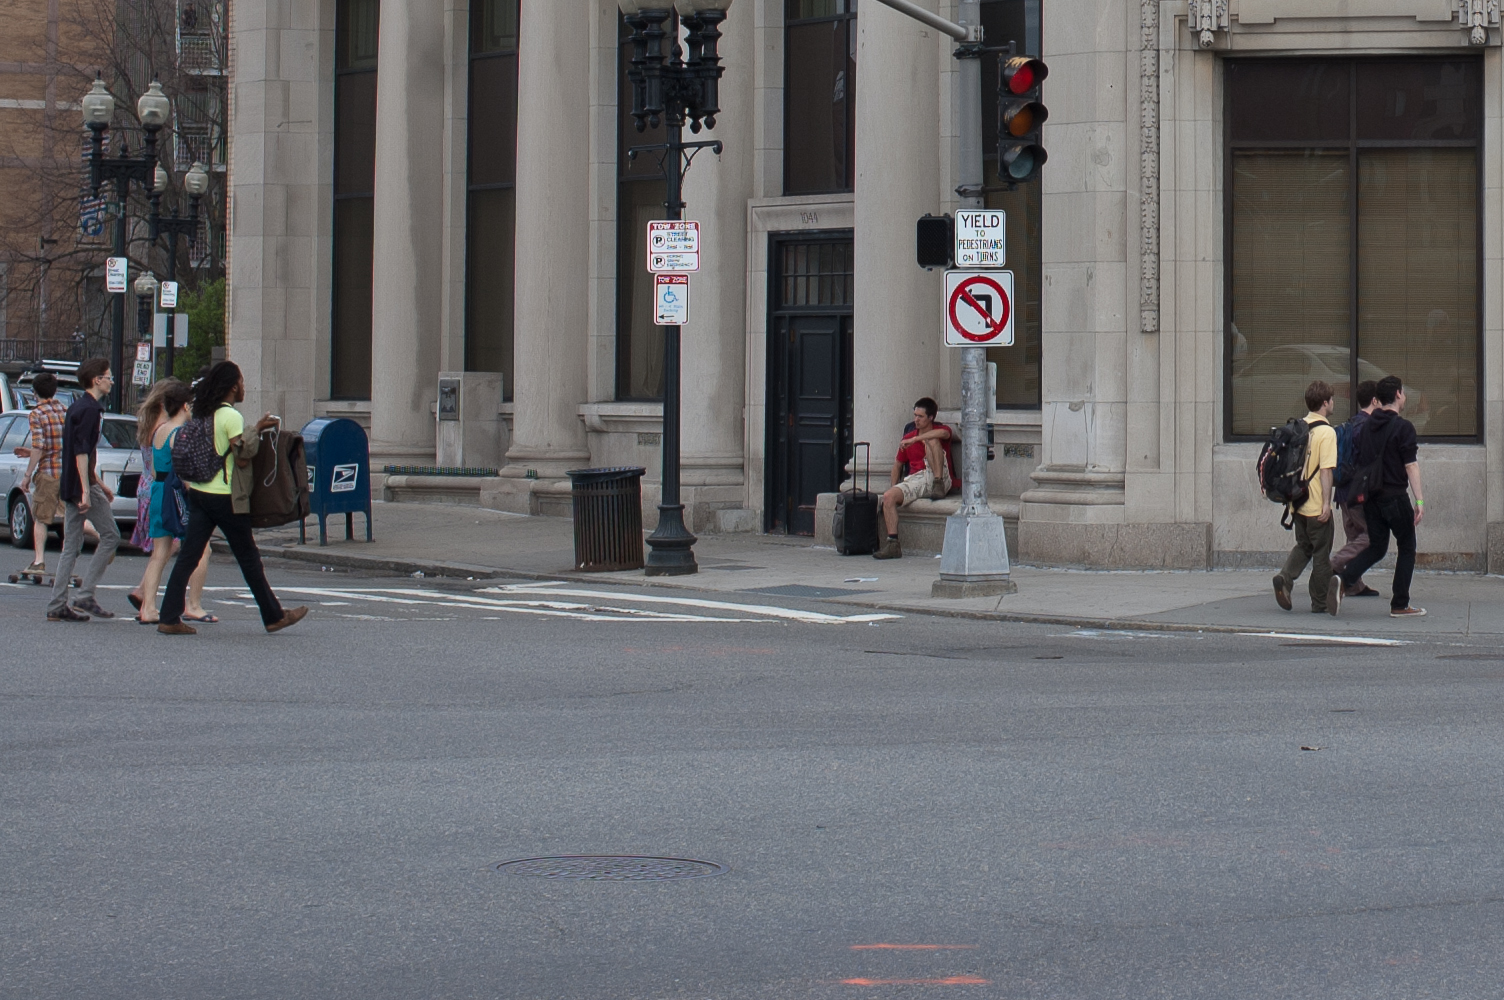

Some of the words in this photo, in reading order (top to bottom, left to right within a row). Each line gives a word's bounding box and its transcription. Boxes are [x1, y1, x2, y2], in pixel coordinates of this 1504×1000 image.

[961, 214, 1000, 228] YIELD
[975, 229, 986, 237] TO
[958, 238, 1003, 250] PEDESTRIANS
[962, 254, 974, 262] ON
[976, 251, 999, 263] TURNS
